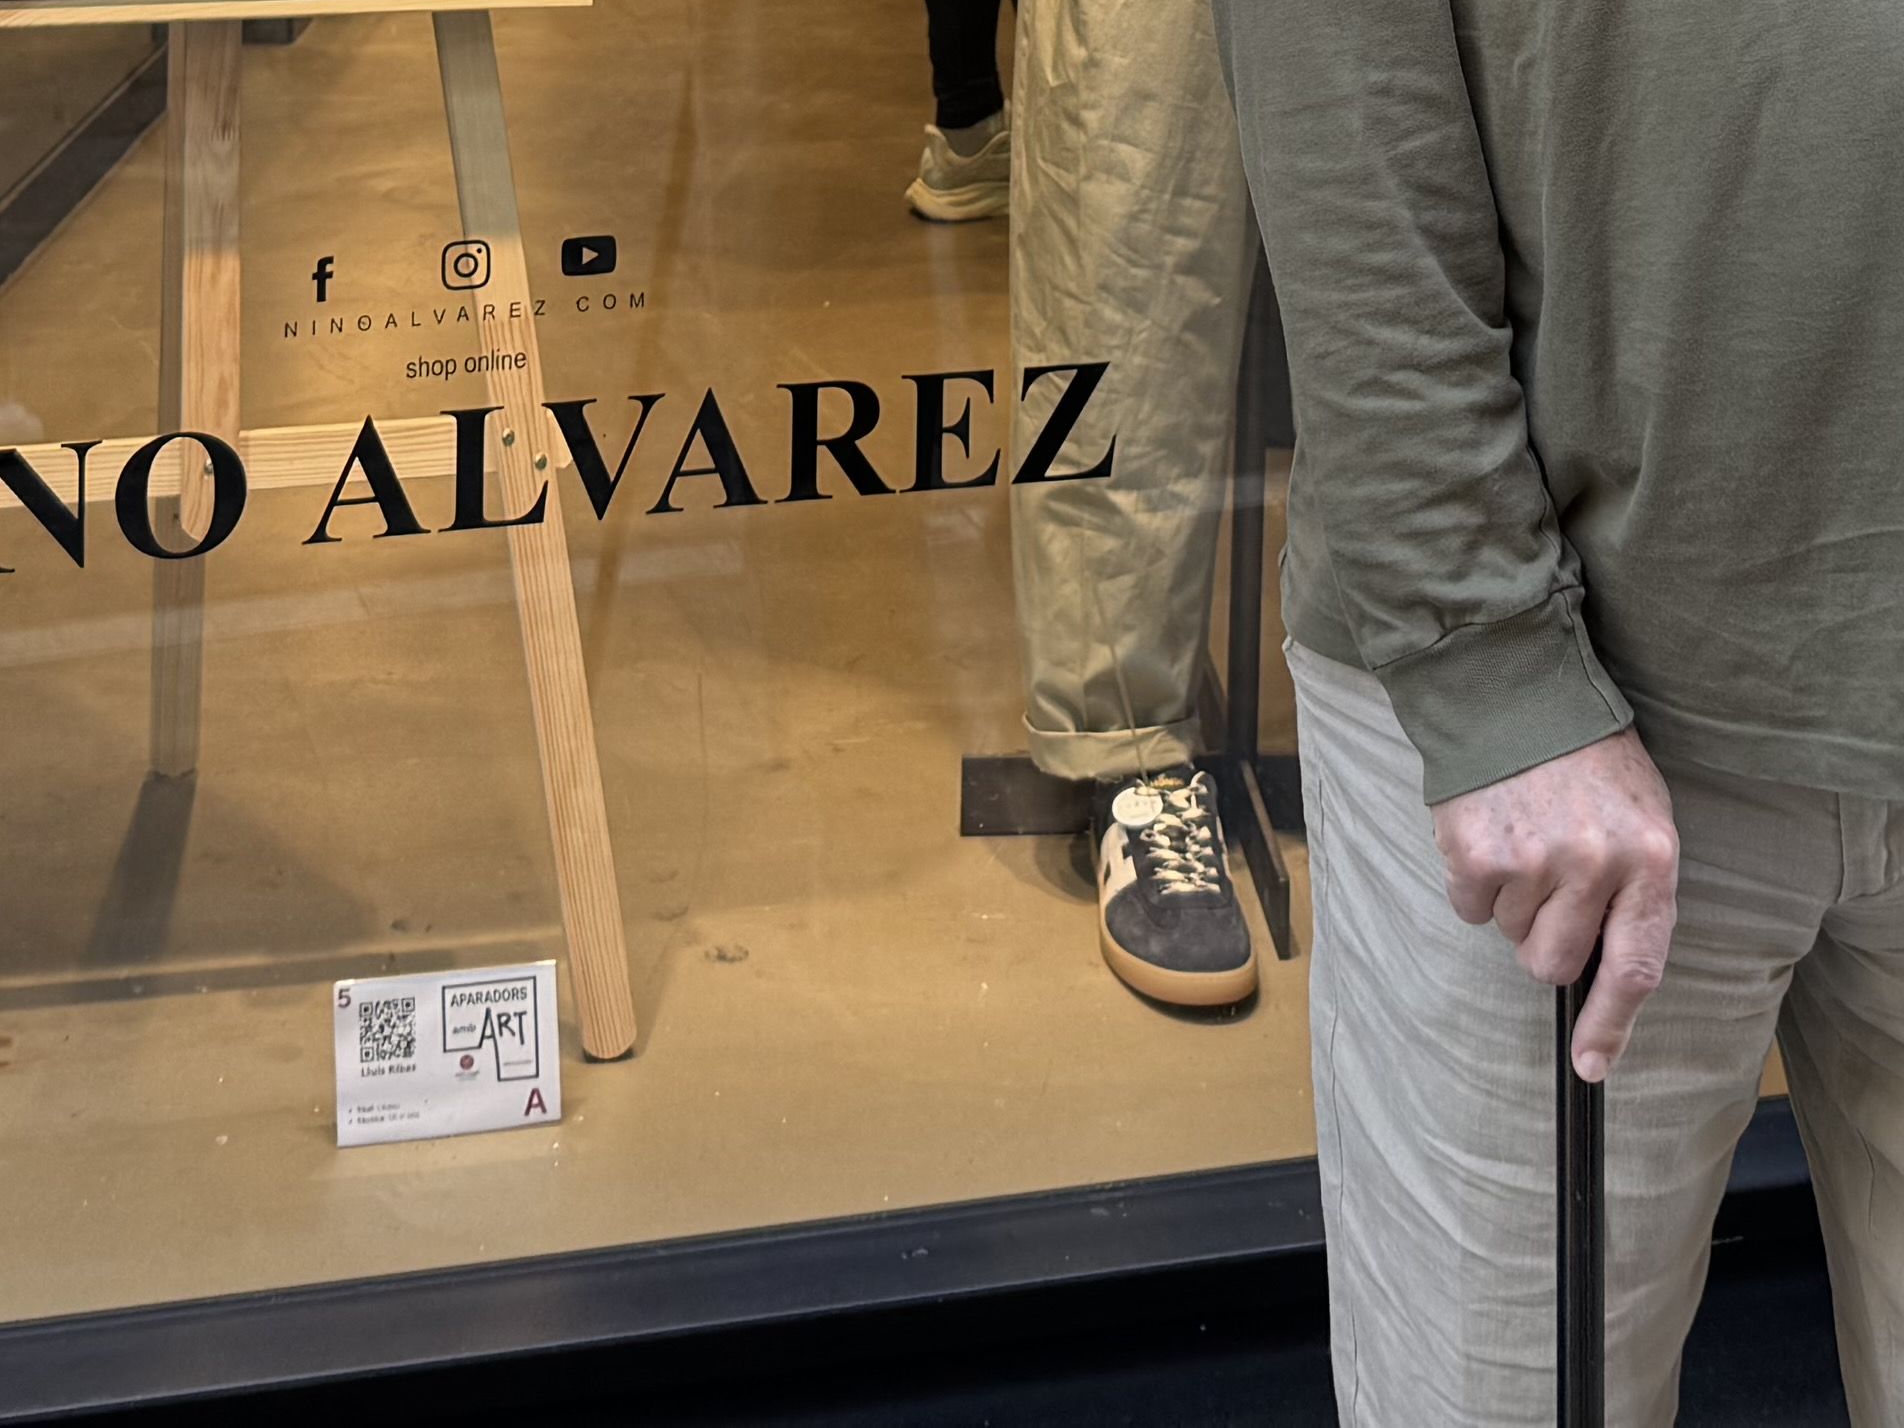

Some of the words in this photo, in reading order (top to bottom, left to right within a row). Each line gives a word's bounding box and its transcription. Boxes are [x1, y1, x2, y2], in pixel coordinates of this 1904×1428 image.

[405, 354, 457, 381] shop
[464, 347, 527, 373] online
[301, 361, 1118, 545] ALVAREZ
[337, 988, 351, 1008] 5
[449, 986, 528, 1008] APARADORS
[478, 1007, 528, 1049] ART
[524, 1087, 547, 1117] A
